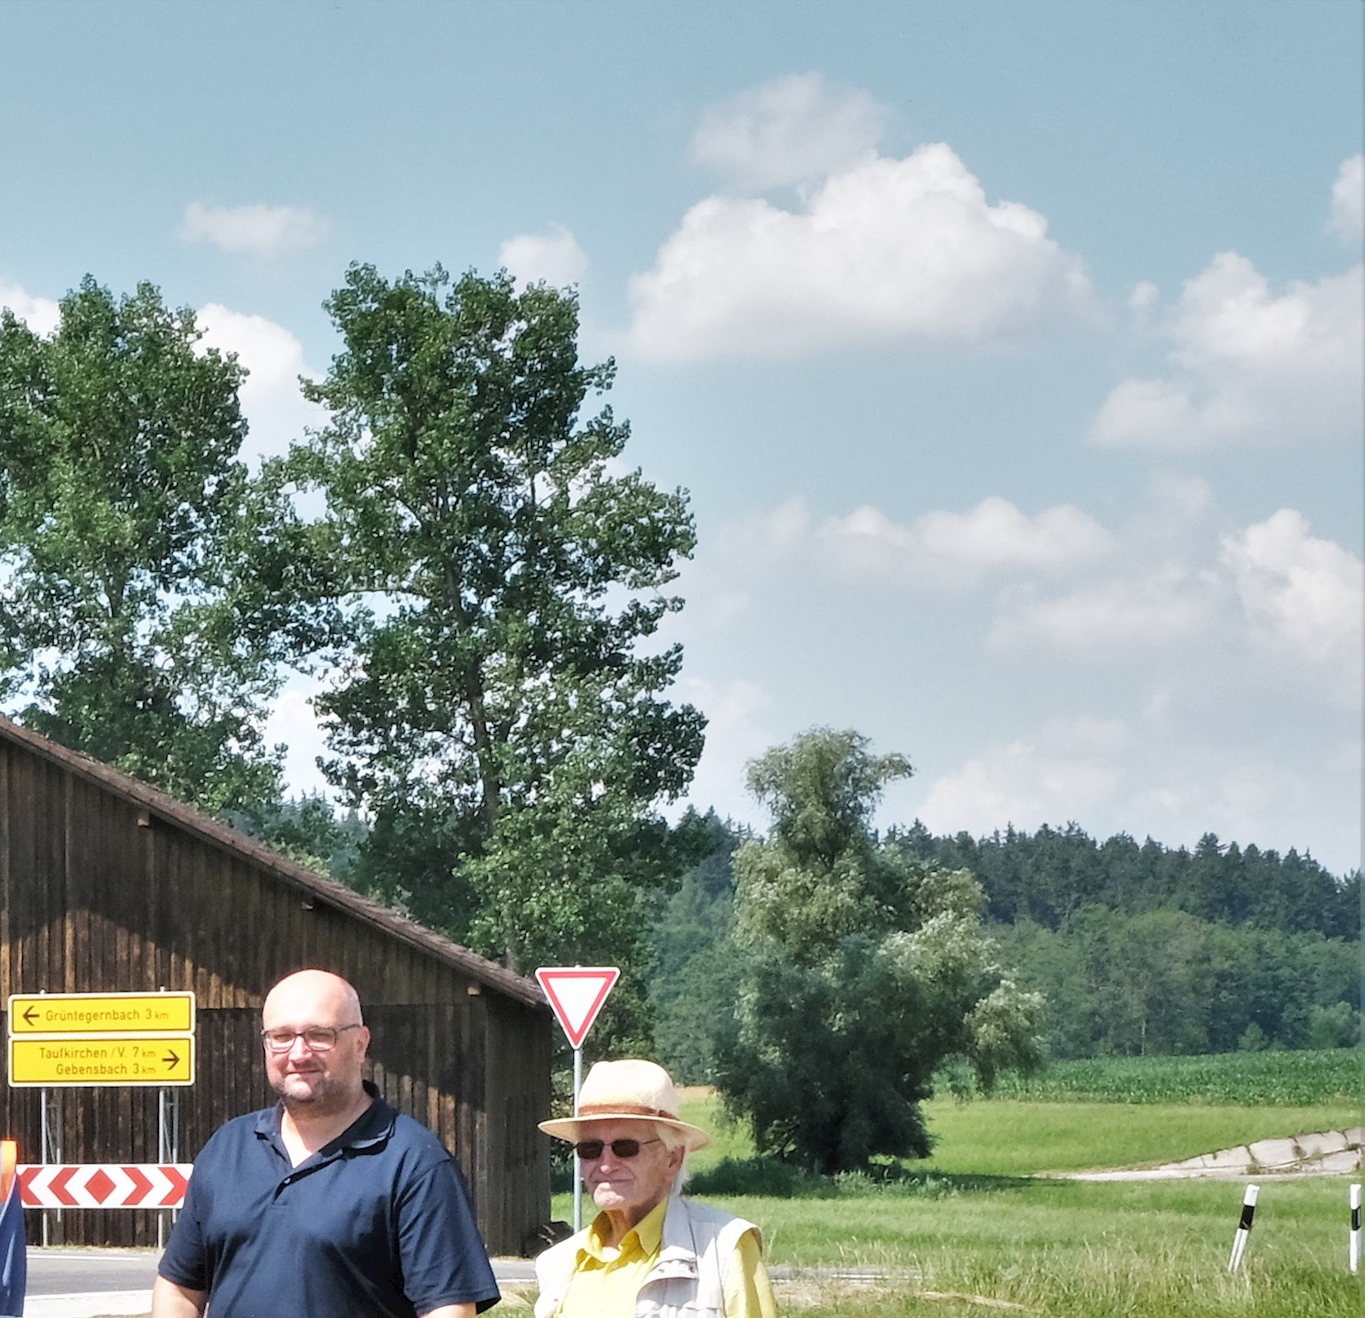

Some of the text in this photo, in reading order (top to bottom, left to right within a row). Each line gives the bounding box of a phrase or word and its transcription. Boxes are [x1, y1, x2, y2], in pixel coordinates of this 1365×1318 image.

[45, 1007, 169, 1024] Grüntegernbach 3 km
[39, 1046, 108, 1059] Taufkirchen
[132, 1046, 140, 1058] 7
[142, 1049, 156, 1058] km
[56, 1062, 157, 1075] Gebensbach 3 km
